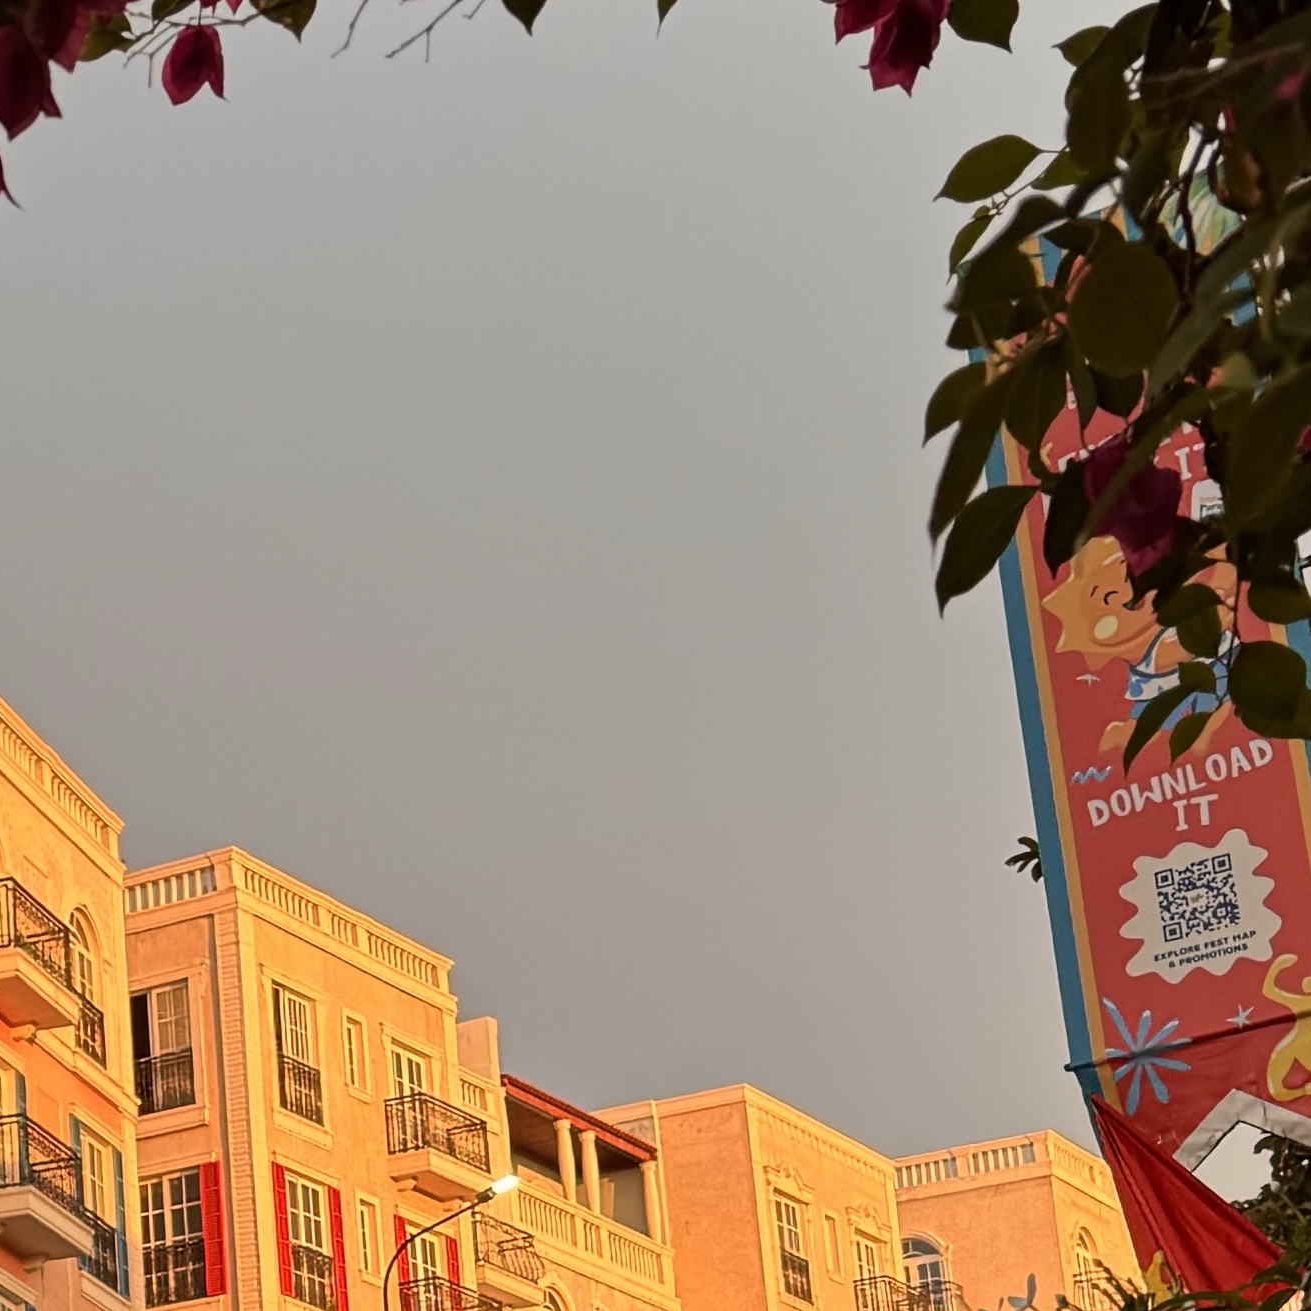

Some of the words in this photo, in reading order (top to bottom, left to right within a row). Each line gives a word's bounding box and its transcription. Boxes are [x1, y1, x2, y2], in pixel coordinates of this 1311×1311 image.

[1087, 739, 1273, 827] DOWNLOAD
[1173, 794, 1218, 831] IT
[1153, 943, 1201, 962] EXPLORE
[1203, 936, 1229, 951] FEST
[1232, 929, 1257, 942] MAP
[1179, 942, 1249, 967] PROMOTIONS
